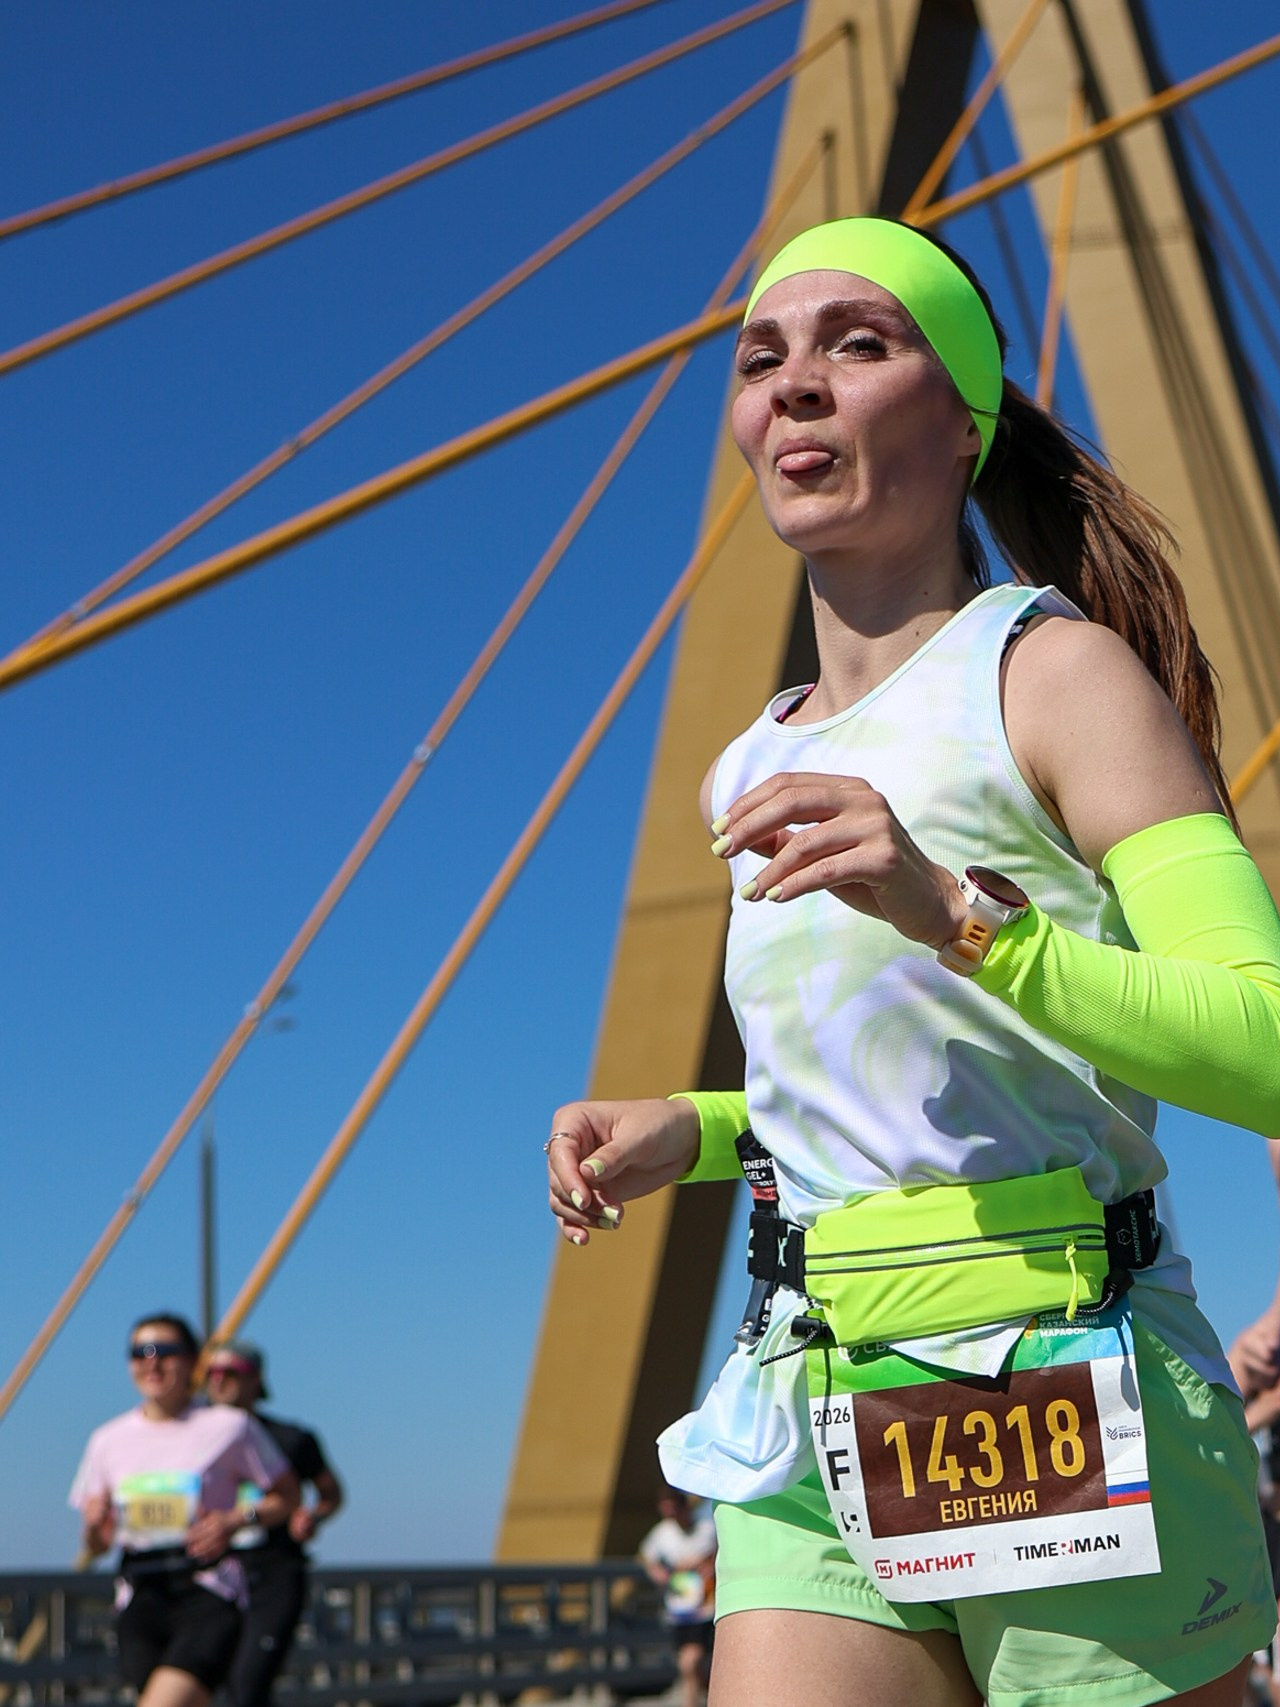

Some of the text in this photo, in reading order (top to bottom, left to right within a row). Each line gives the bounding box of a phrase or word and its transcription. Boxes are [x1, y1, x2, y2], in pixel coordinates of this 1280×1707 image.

[1040, 1316, 1100, 1329] КАЗАНСКИЙ
[1040, 1327, 1089, 1338] МАРАФОН
[813, 1406, 851, 1427] 2026
[1119, 1430, 1142, 1440] BRICS
[882, 1398, 1086, 1499] 14318
[825, 1448, 851, 1491] F
[939, 1489, 1038, 1523] ЕВГЕНИЯ
[896, 1552, 976, 1576] МАГНИТ
[1181, 1601, 1243, 1636] DEMIX
